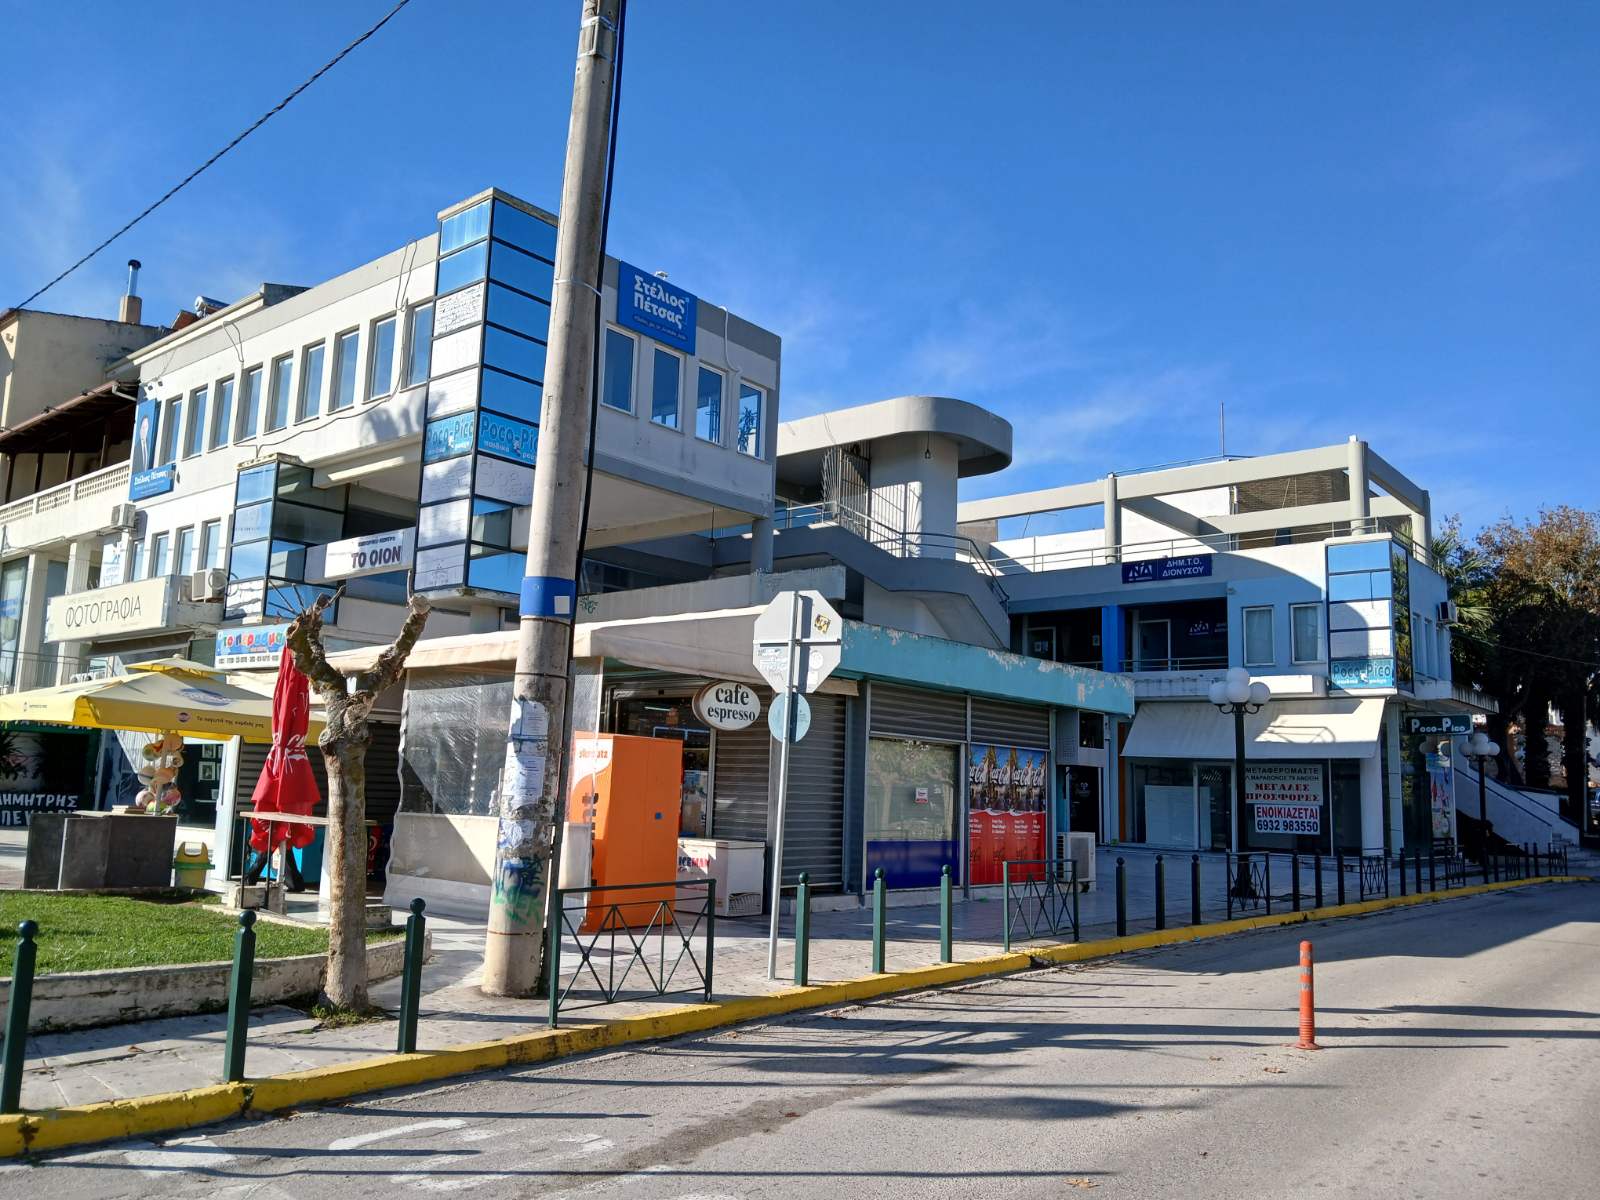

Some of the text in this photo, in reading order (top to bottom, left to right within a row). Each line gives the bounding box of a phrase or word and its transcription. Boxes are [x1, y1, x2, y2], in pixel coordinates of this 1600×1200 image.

[634, 274, 685, 314] Στέλιος
[634, 291, 683, 330] Πέτσας
[1166, 558, 1202, 568] ΔΗΜ.Τ.Ο.
[1162, 566, 1205, 577] ΔΙΟΝΥΣΟΥ
[65, 595, 142, 628] ΦΩΤΟΓΡΑΦΙΑ
[715, 683, 749, 706] cafe
[707, 706, 756, 722] espresso
[1411, 717, 1466, 733] Poco-Pico
[579, 750, 608, 759] skrutz
[1254, 783, 1310, 792] ΜΕΓΑΛΕΣ
[0, 793, 79, 808] ΗΜΗΤΡΗΣ
[1245, 793, 1320, 802] ΠΡΟΣΦΟΡΕΣ
[1256, 806, 1318, 820] ΕΝΟΙΚΙΑΖΕΤΑΙ
[1256, 819, 1319, 832] 6932 983550
